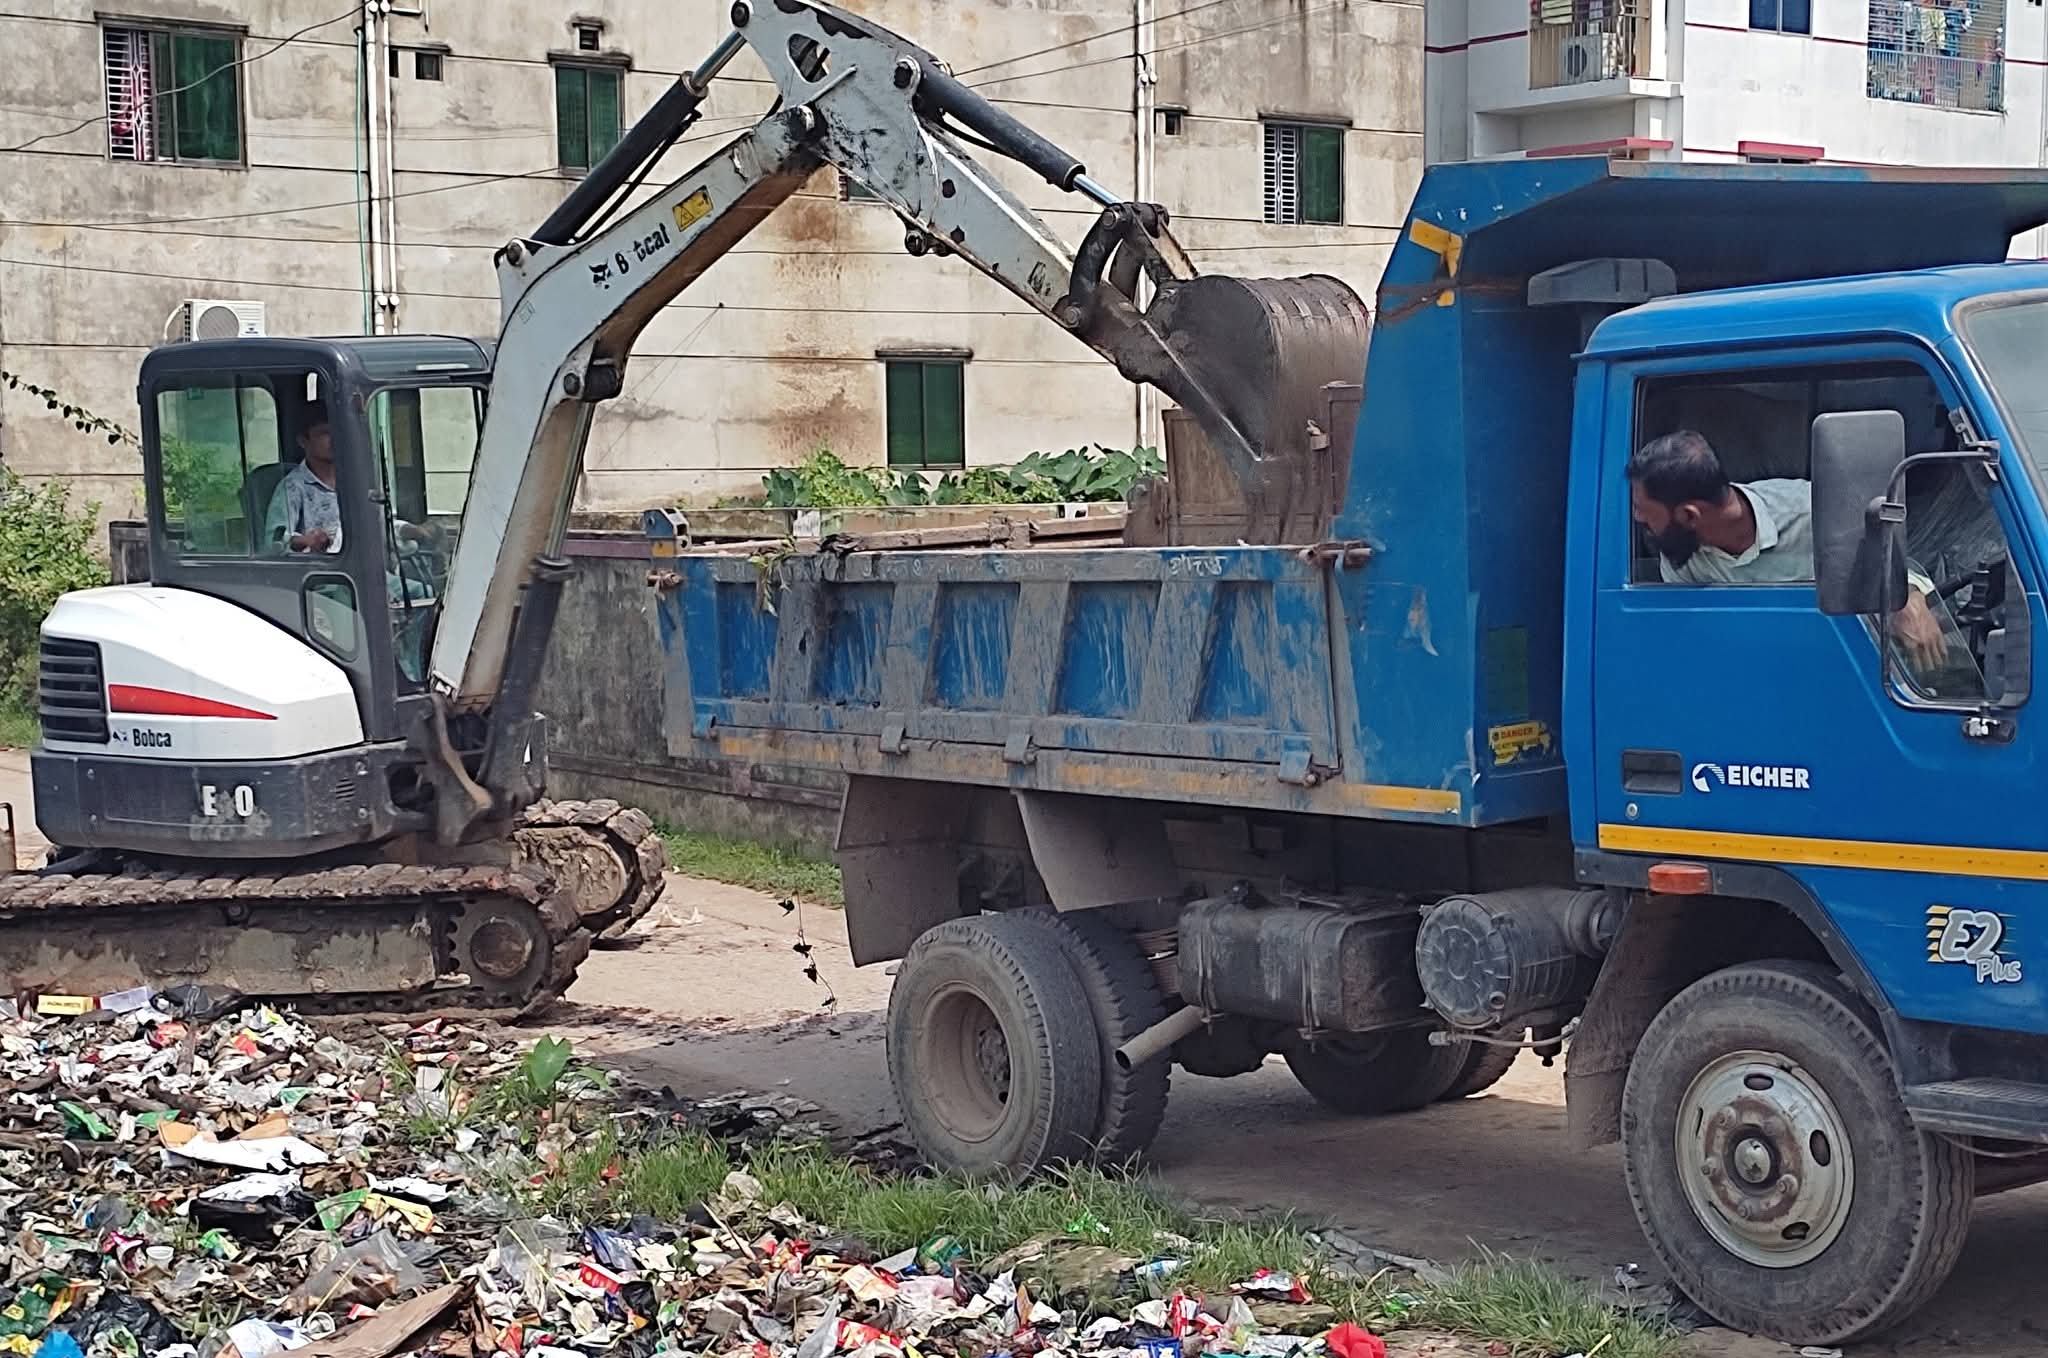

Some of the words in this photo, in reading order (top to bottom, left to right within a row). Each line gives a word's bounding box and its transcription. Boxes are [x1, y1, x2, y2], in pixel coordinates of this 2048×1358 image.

[1727, 765, 1810, 789] EICHER
[1939, 909, 2003, 963] E2
[1976, 954, 2022, 983] Plus
